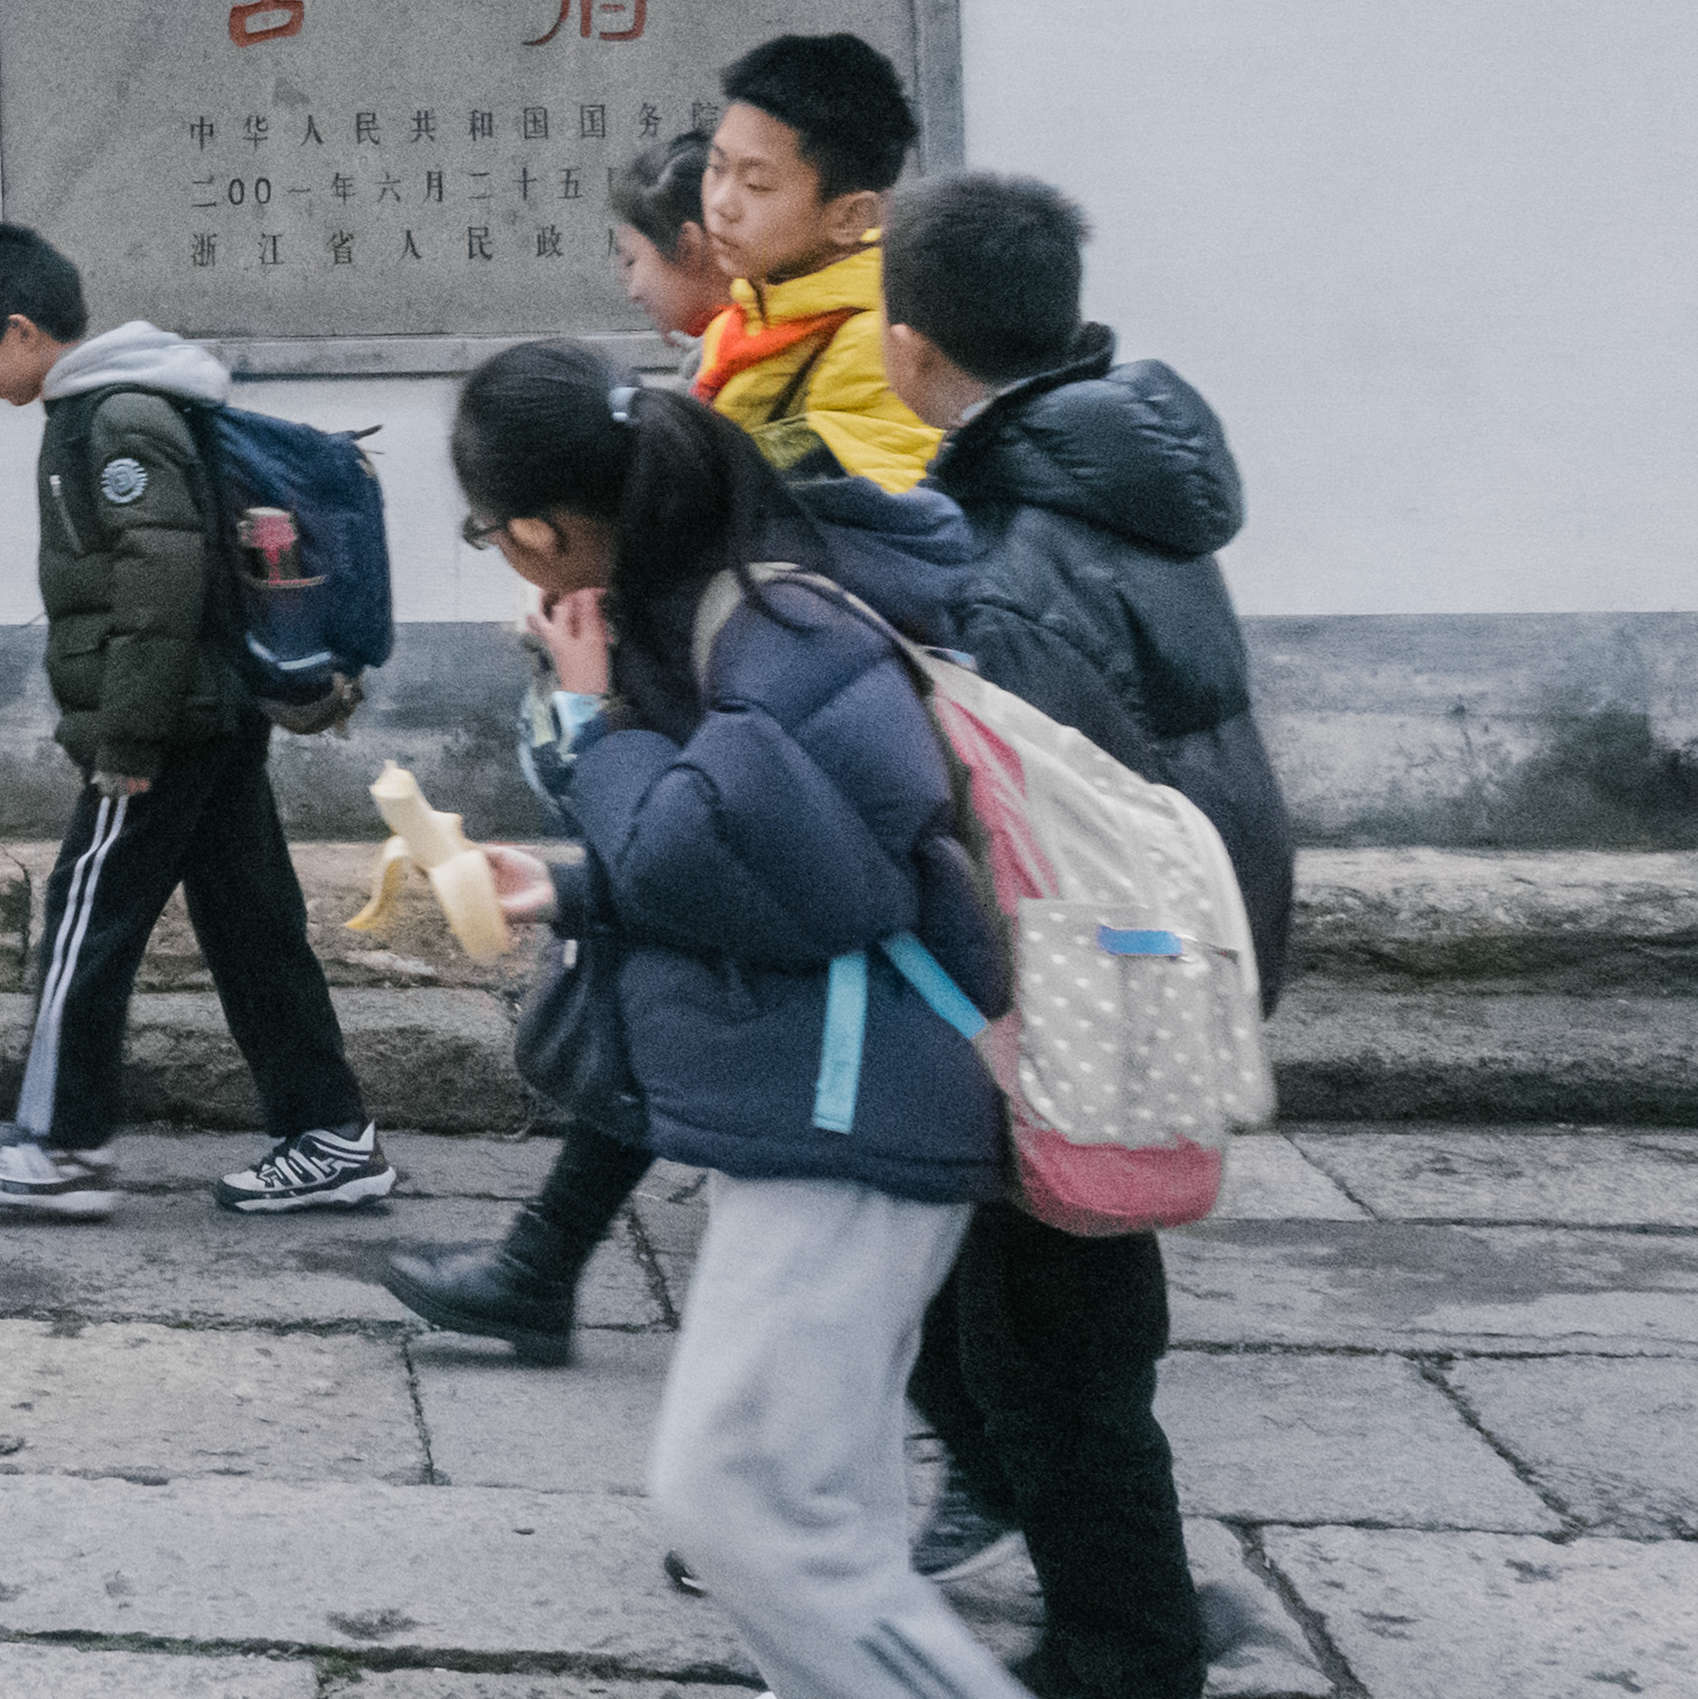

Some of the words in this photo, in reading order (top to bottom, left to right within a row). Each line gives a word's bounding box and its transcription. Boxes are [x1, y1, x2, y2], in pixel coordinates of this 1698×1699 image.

[190, 224, 620, 267] 浙江省人民政
